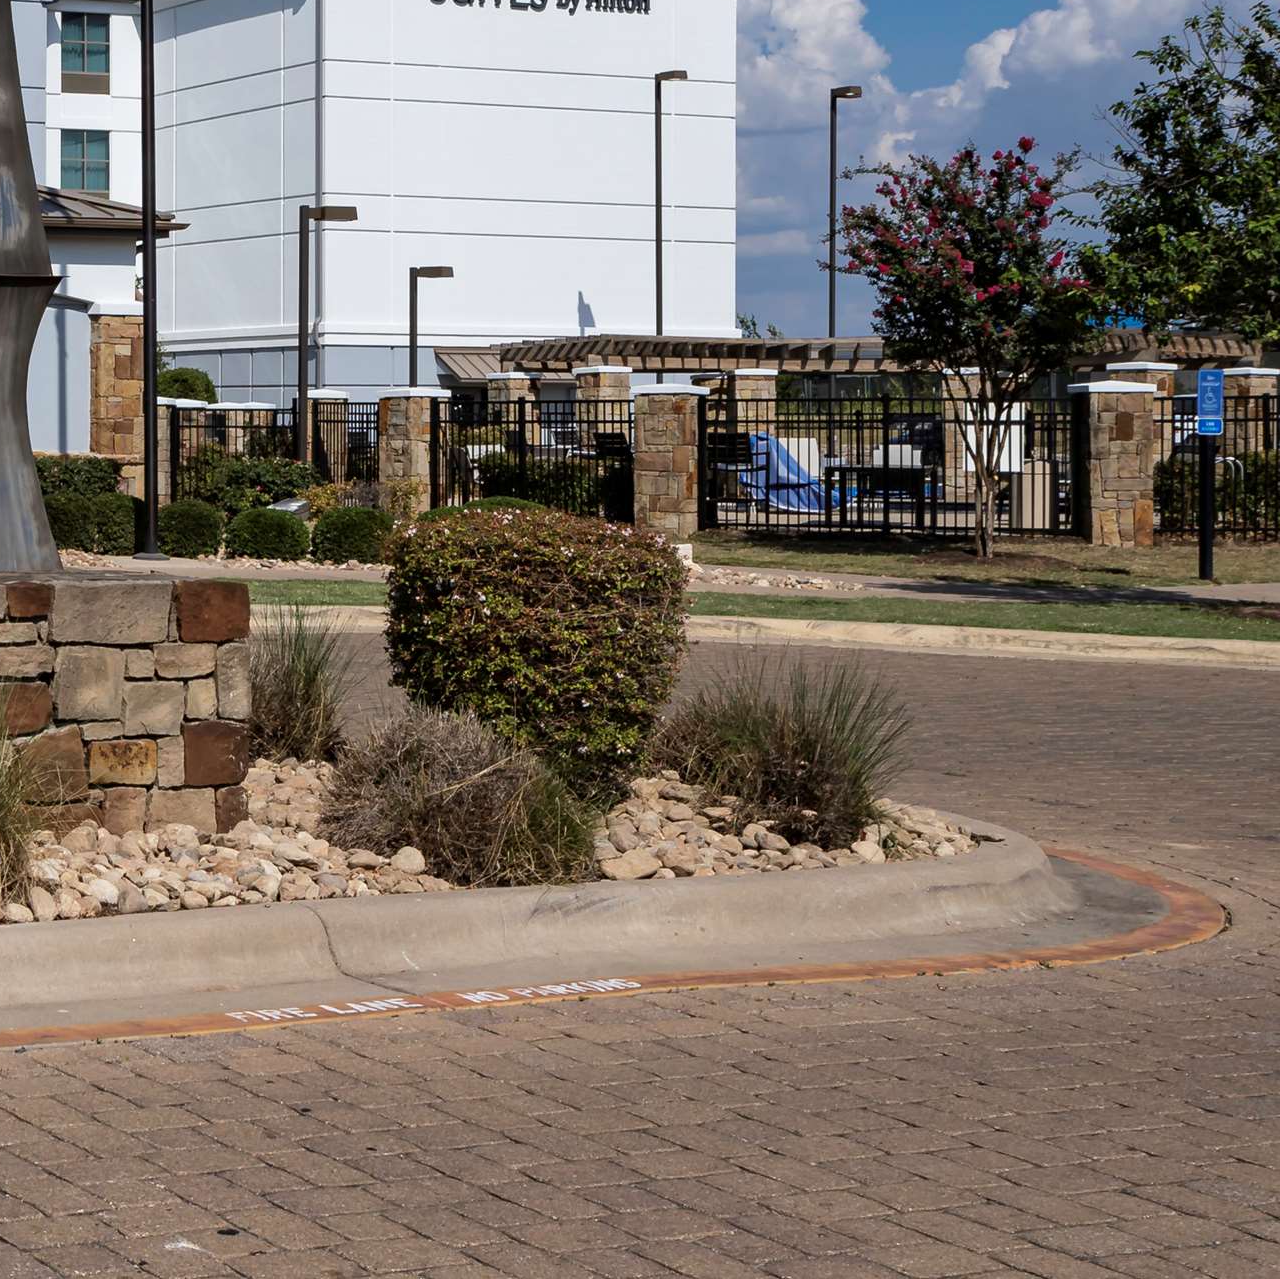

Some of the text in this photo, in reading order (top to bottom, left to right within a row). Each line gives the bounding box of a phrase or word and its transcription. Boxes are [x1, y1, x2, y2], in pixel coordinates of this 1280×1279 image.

[225, 978, 642, 1023] FIRE LANE NO PARKING
